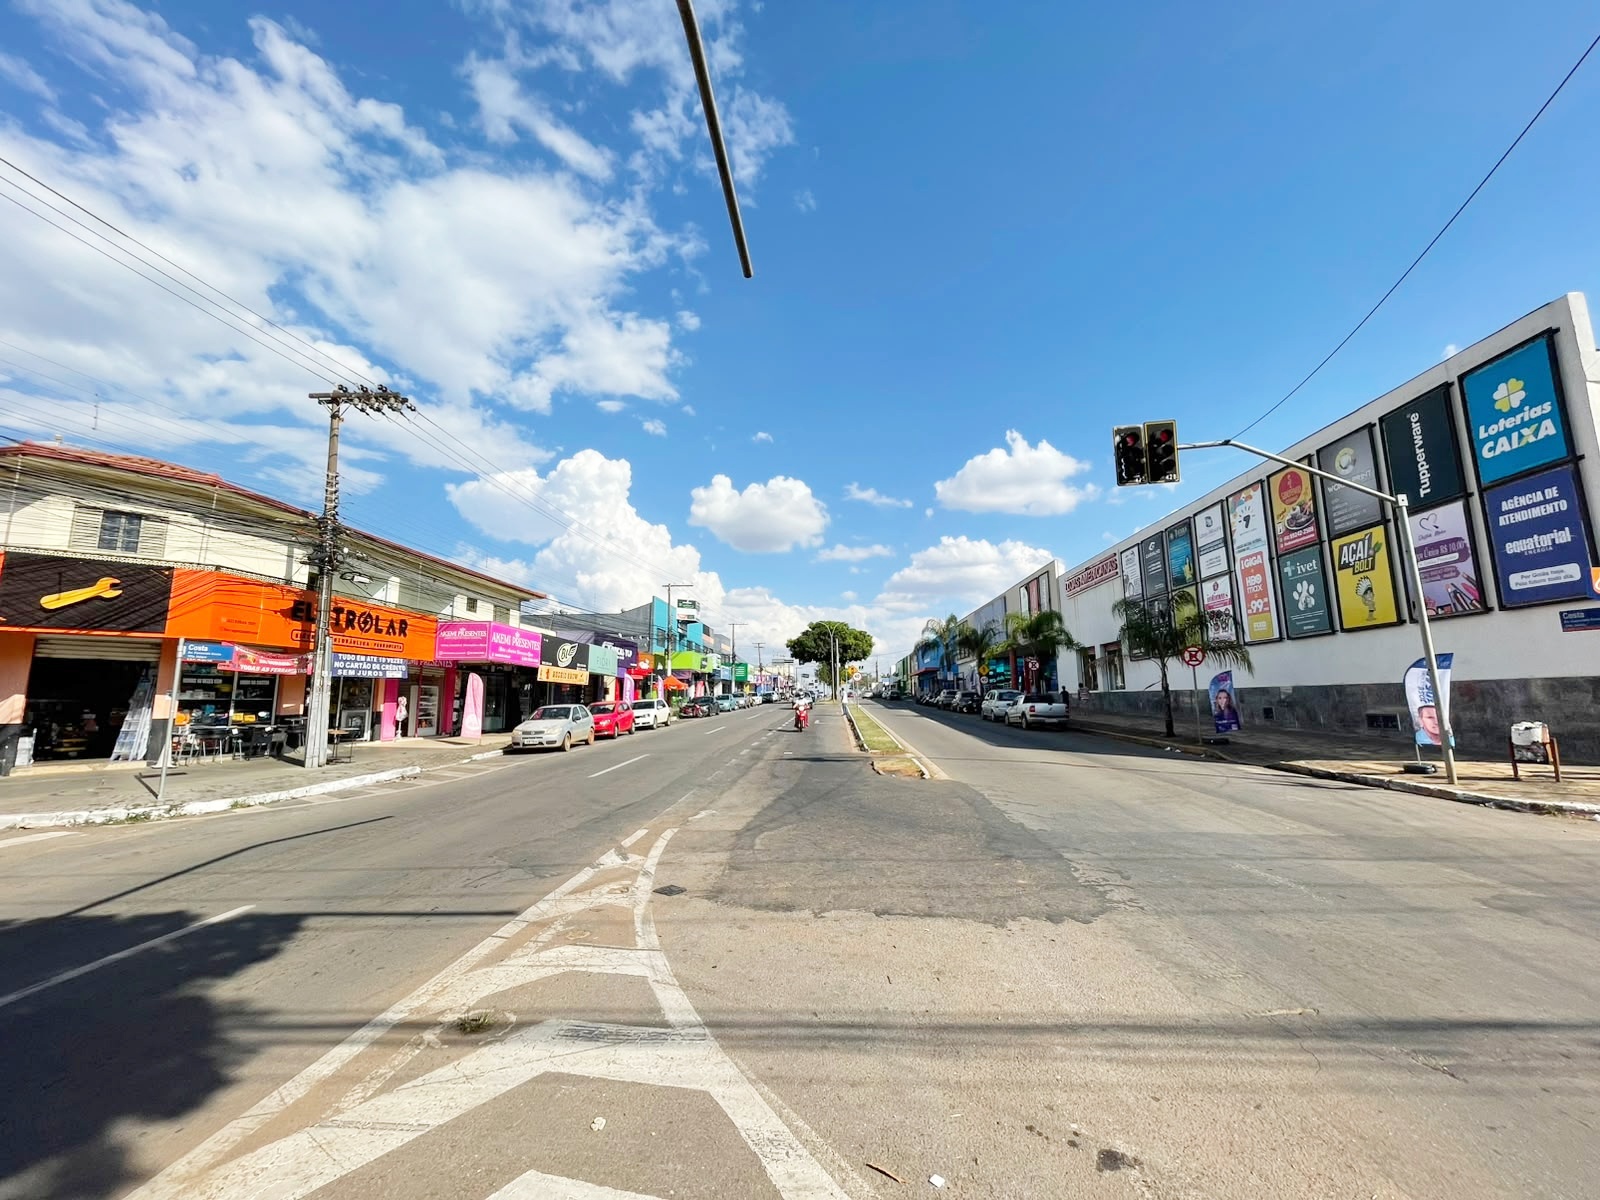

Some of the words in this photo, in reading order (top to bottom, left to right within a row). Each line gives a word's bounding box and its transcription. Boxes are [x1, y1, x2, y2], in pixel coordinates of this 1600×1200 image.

[1479, 401, 1552, 440] Loterias
[1482, 418, 1557, 459] CAIXA
[1410, 412, 1431, 498] Tupperware
[1501, 490, 1544, 512] AGÊNCIA
[1544, 486, 1560, 500] DE
[1499, 499, 1568, 526] ATENDIMENTO
[1341, 533, 1370, 566] AÇAÍ
[1505, 527, 1572, 555] equatorial
[1244, 554, 1263, 568] GIGA
[1296, 559, 1318, 574] ivet
[1354, 558, 1373, 573] BOLT
[1246, 574, 1262, 587] HBO
[1247, 583, 1264, 595] max
[290, 600, 409, 638] ELTROLAR
[188, 644, 209, 652] Costa
[491, 631, 512, 646] AKEMI
[511, 636, 541, 651] PRESENTES
[338, 653, 355, 661] TUDO
[345, 661, 371, 670] CARTÃO
[380, 662, 406, 672] CRÉDITO
